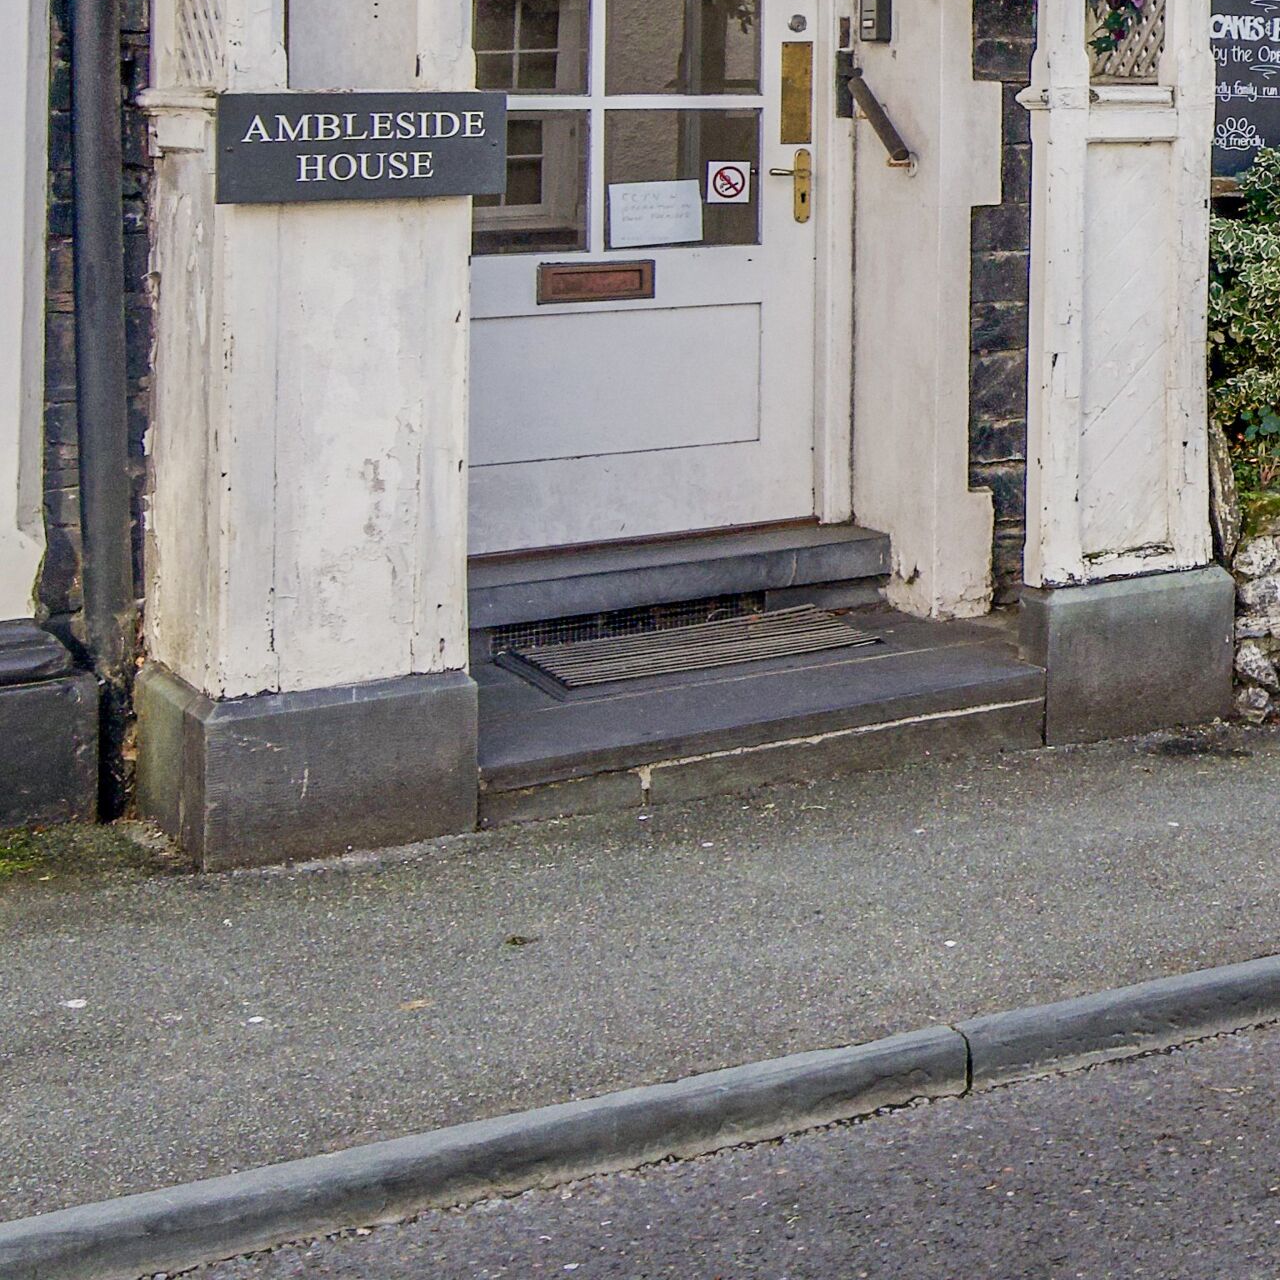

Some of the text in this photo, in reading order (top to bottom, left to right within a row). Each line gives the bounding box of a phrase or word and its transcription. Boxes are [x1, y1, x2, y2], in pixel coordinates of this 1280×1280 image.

[1210, 14, 1265, 40] CAKES
[1212, 44, 1228, 67] by
[1231, 45, 1253, 63] the
[1234, 80, 1258, 102] family
[1262, 86, 1278, 96] run
[241, 110, 487, 144] AMBLESIDE
[295, 151, 435, 183] HOUSE
